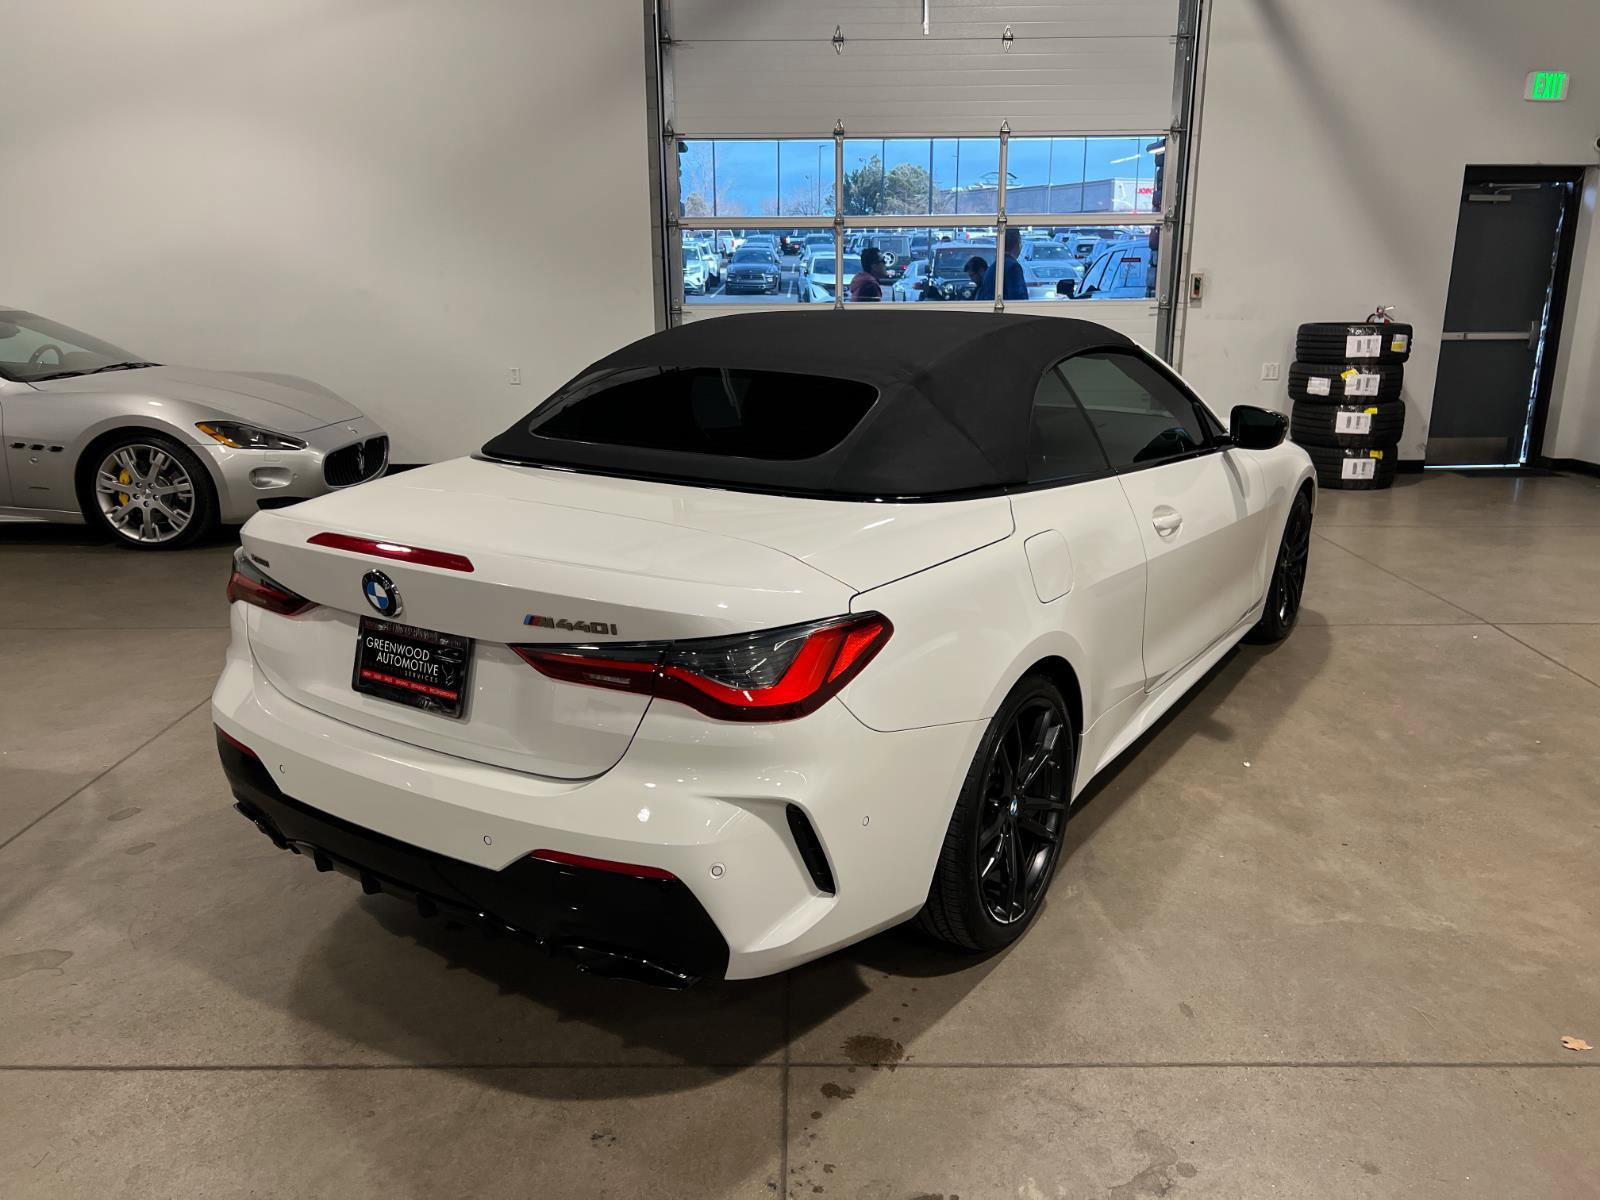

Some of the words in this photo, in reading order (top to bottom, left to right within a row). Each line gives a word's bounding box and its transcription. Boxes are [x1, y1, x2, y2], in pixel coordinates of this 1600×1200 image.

[1532, 72, 1567, 99] EXIT
[366, 636, 430, 661] GREENWOOD
[376, 651, 440, 677] AUTOMOTIVE
